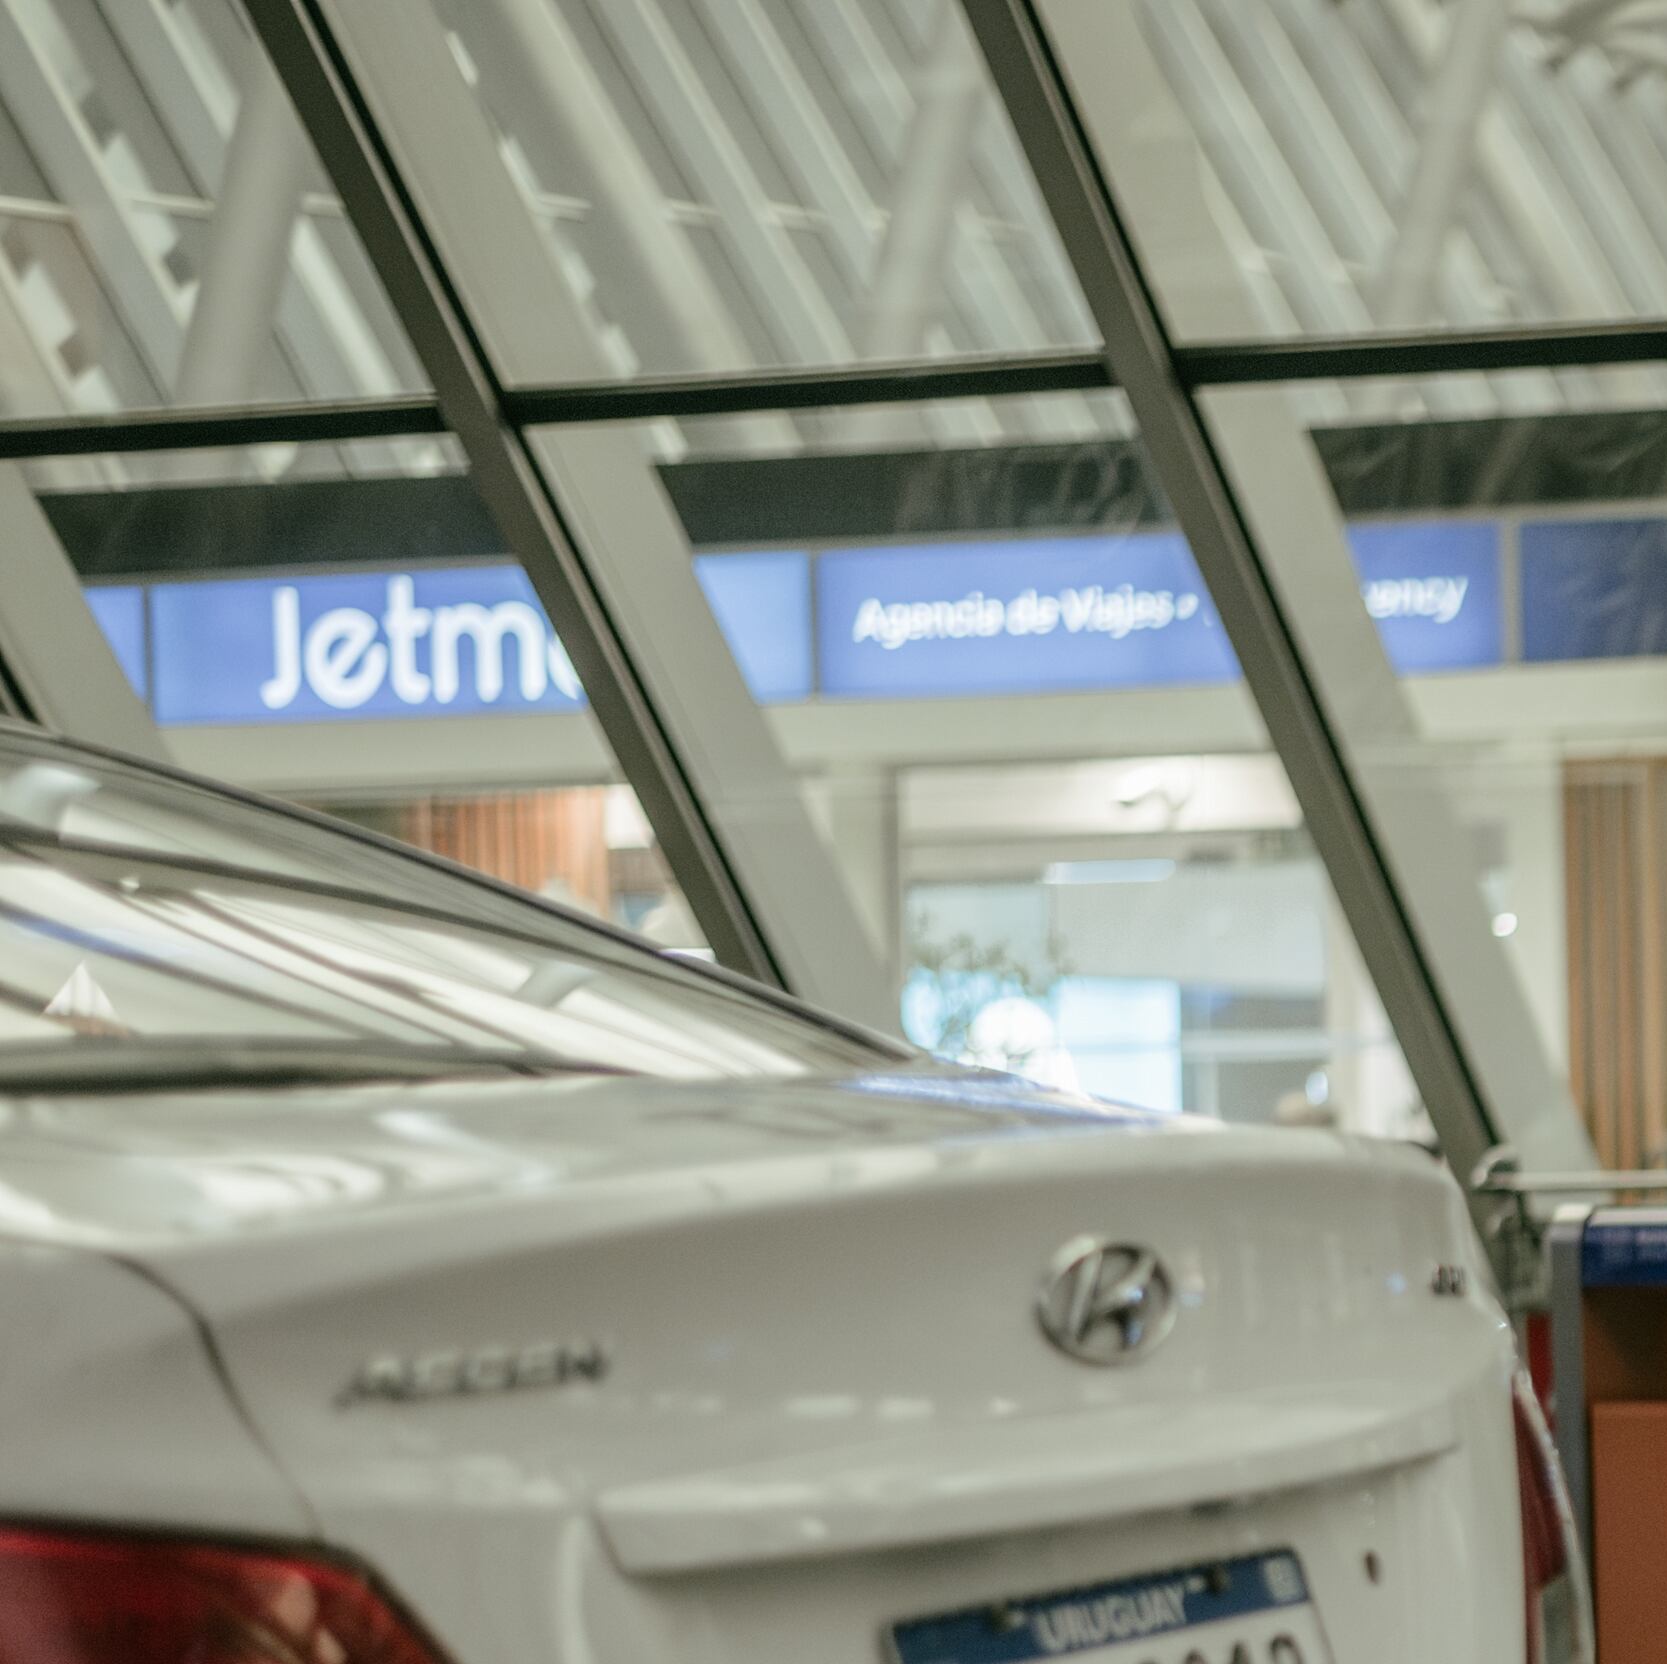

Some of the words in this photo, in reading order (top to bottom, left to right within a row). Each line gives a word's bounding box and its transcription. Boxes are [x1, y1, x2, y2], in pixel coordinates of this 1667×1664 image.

[261, 574, 585, 709] Jetm
[852, 590, 1005, 650] Agencia
[1006, 588, 1060, 636] de
[1060, 583, 1175, 639] Viajes
[1033, 1584, 1189, 1654] URUGUAY
